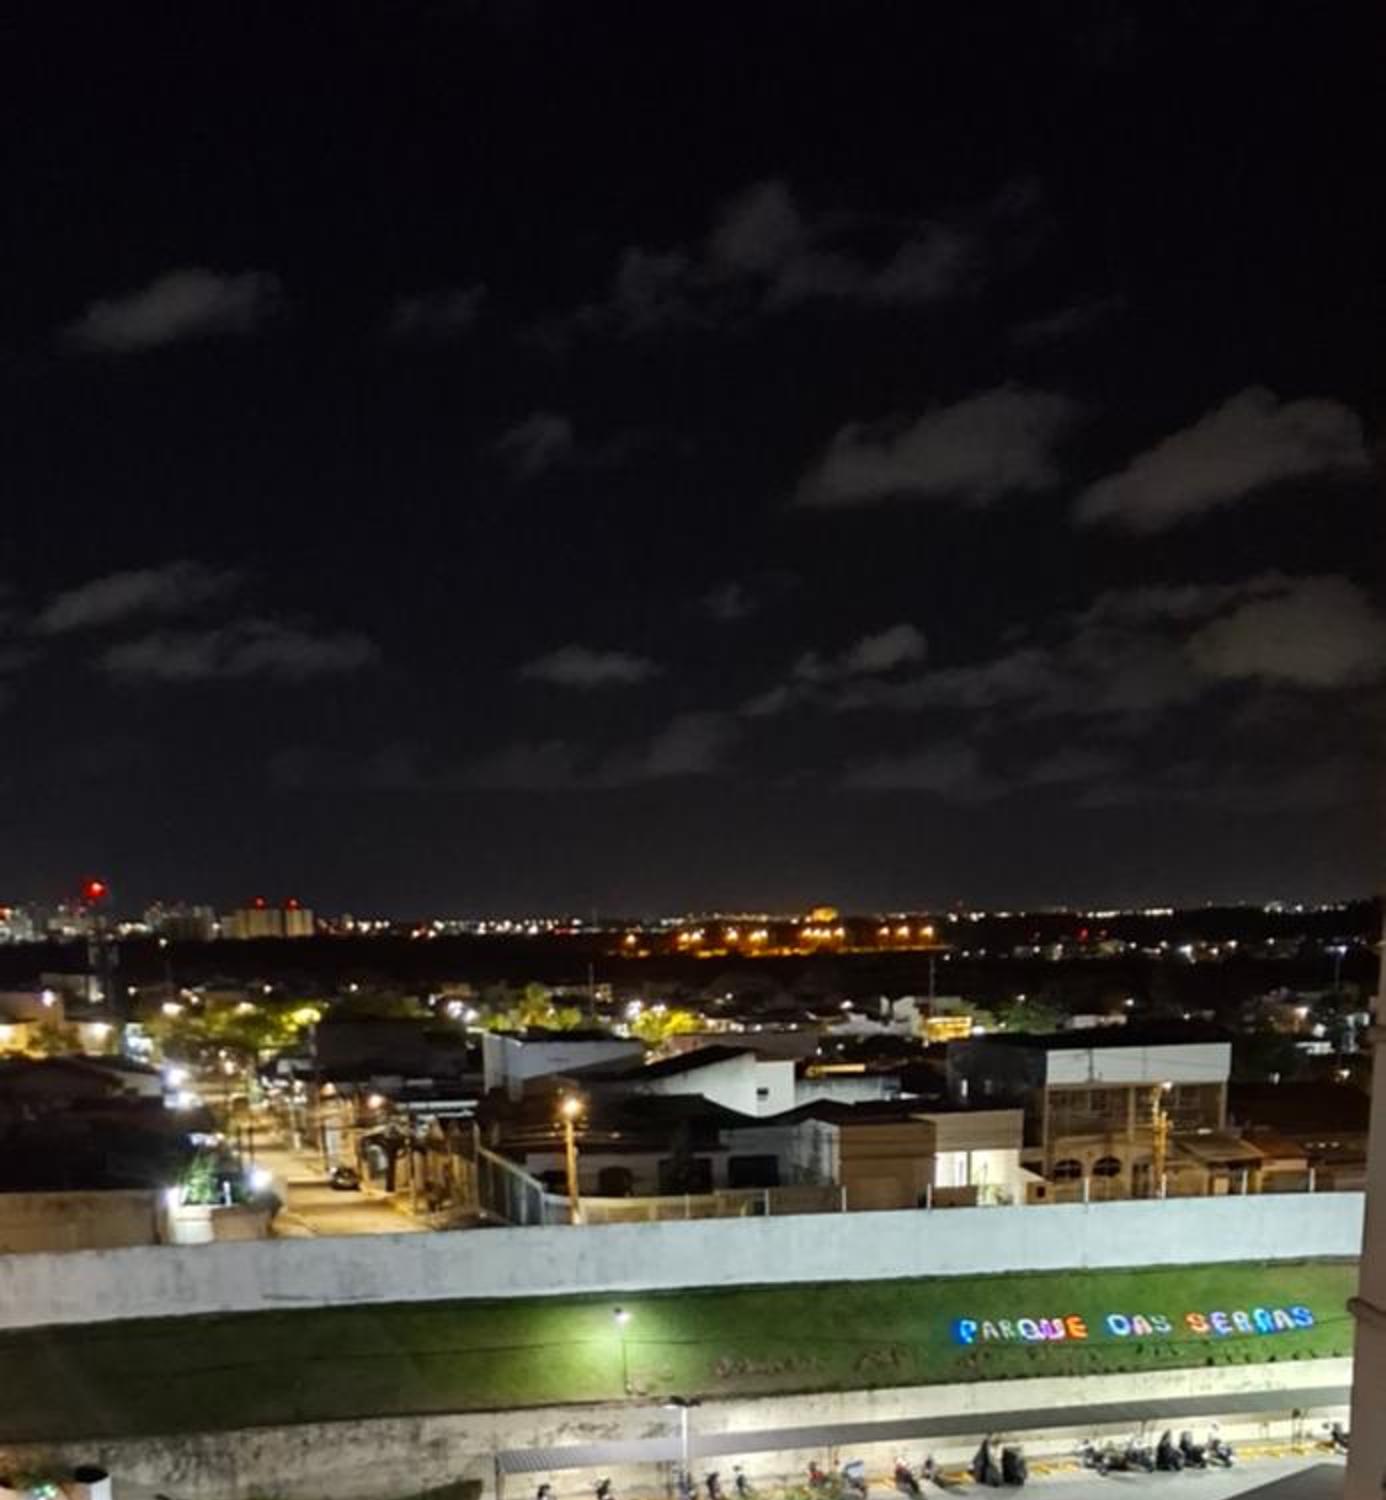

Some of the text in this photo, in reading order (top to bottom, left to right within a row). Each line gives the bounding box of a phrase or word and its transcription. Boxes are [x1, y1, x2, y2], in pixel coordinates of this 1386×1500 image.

[957, 1306, 1313, 1343] PARQUE DAS SERRAS
